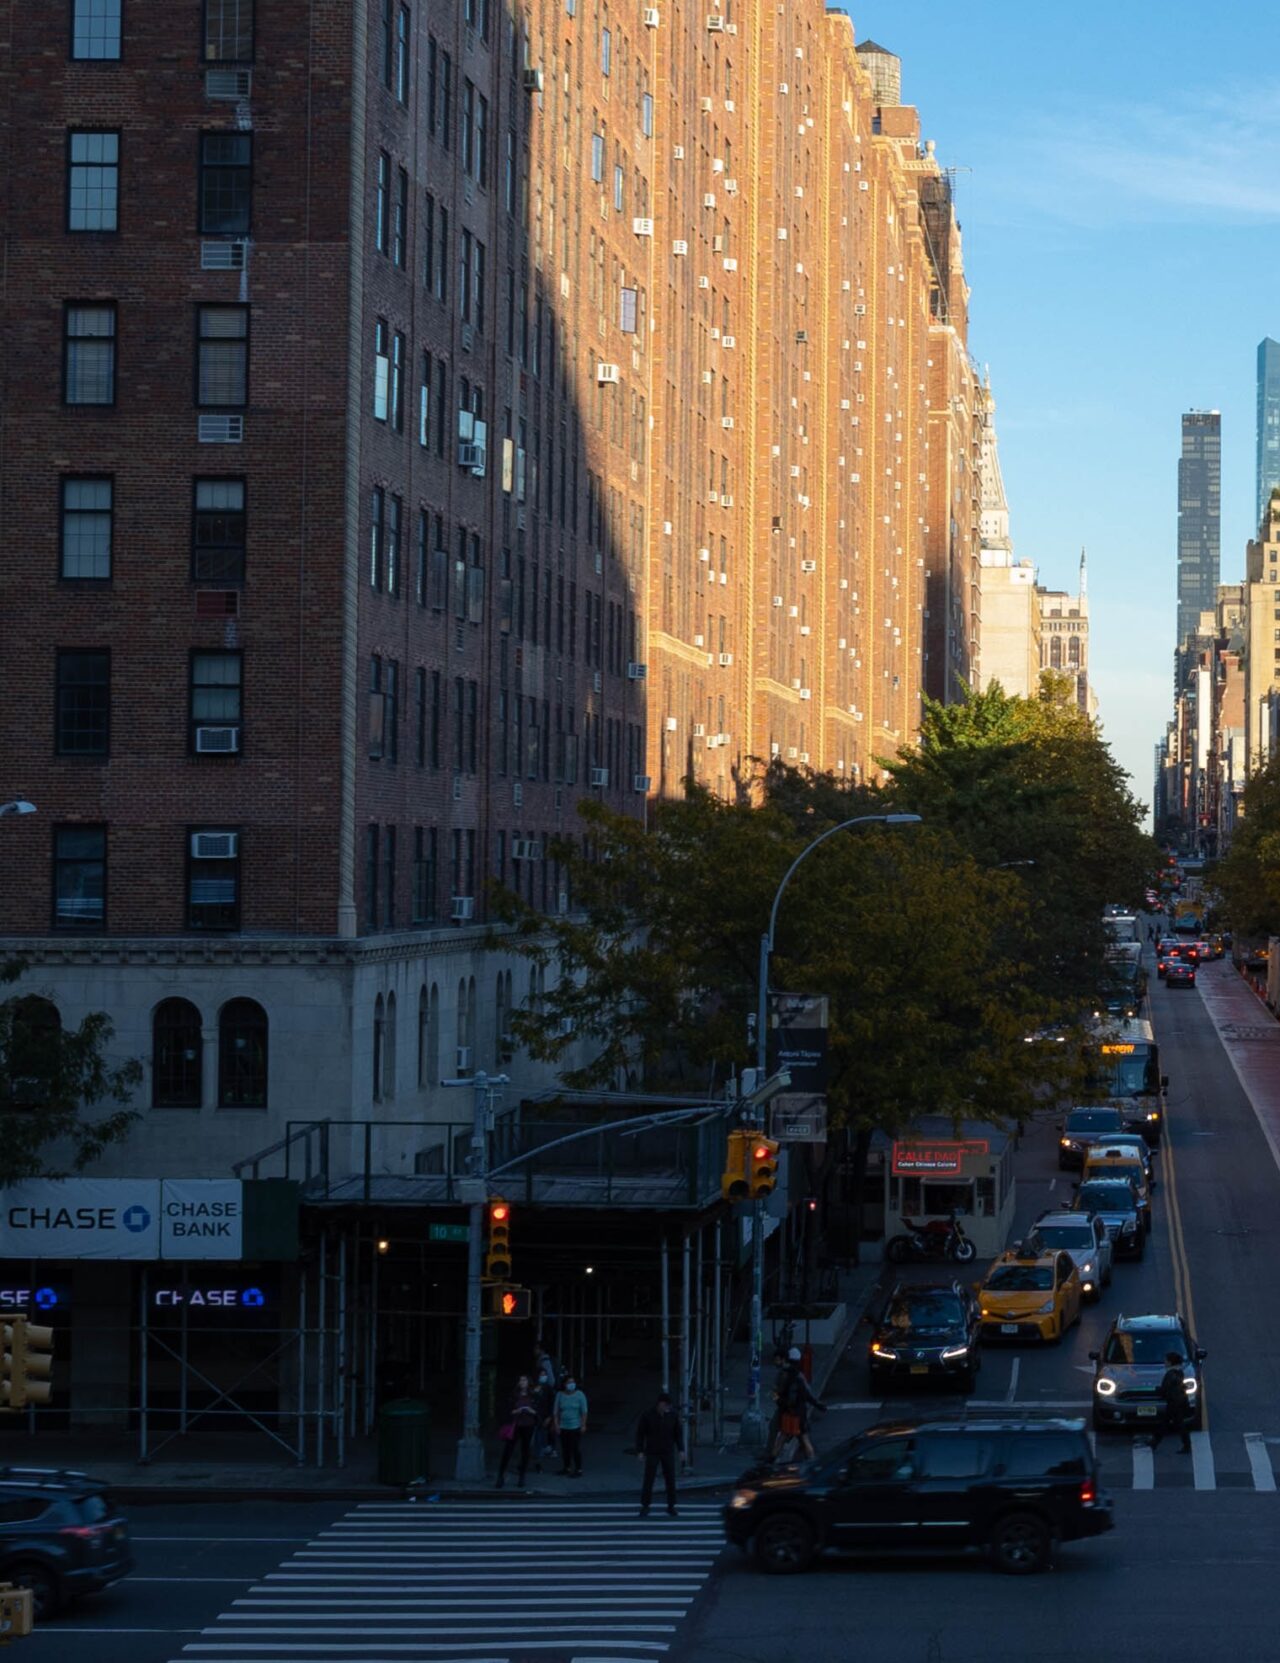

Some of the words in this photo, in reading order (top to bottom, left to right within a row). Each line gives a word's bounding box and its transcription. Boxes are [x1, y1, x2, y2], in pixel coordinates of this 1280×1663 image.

[898, 1152, 932, 1161] CALLE
[935, 1152, 957, 1161] DAO
[166, 1202, 237, 1217] CHASE
[9, 1207, 117, 1230] CHASE
[172, 1222, 231, 1236] BANK
[435, 1227, 447, 1239] 10
